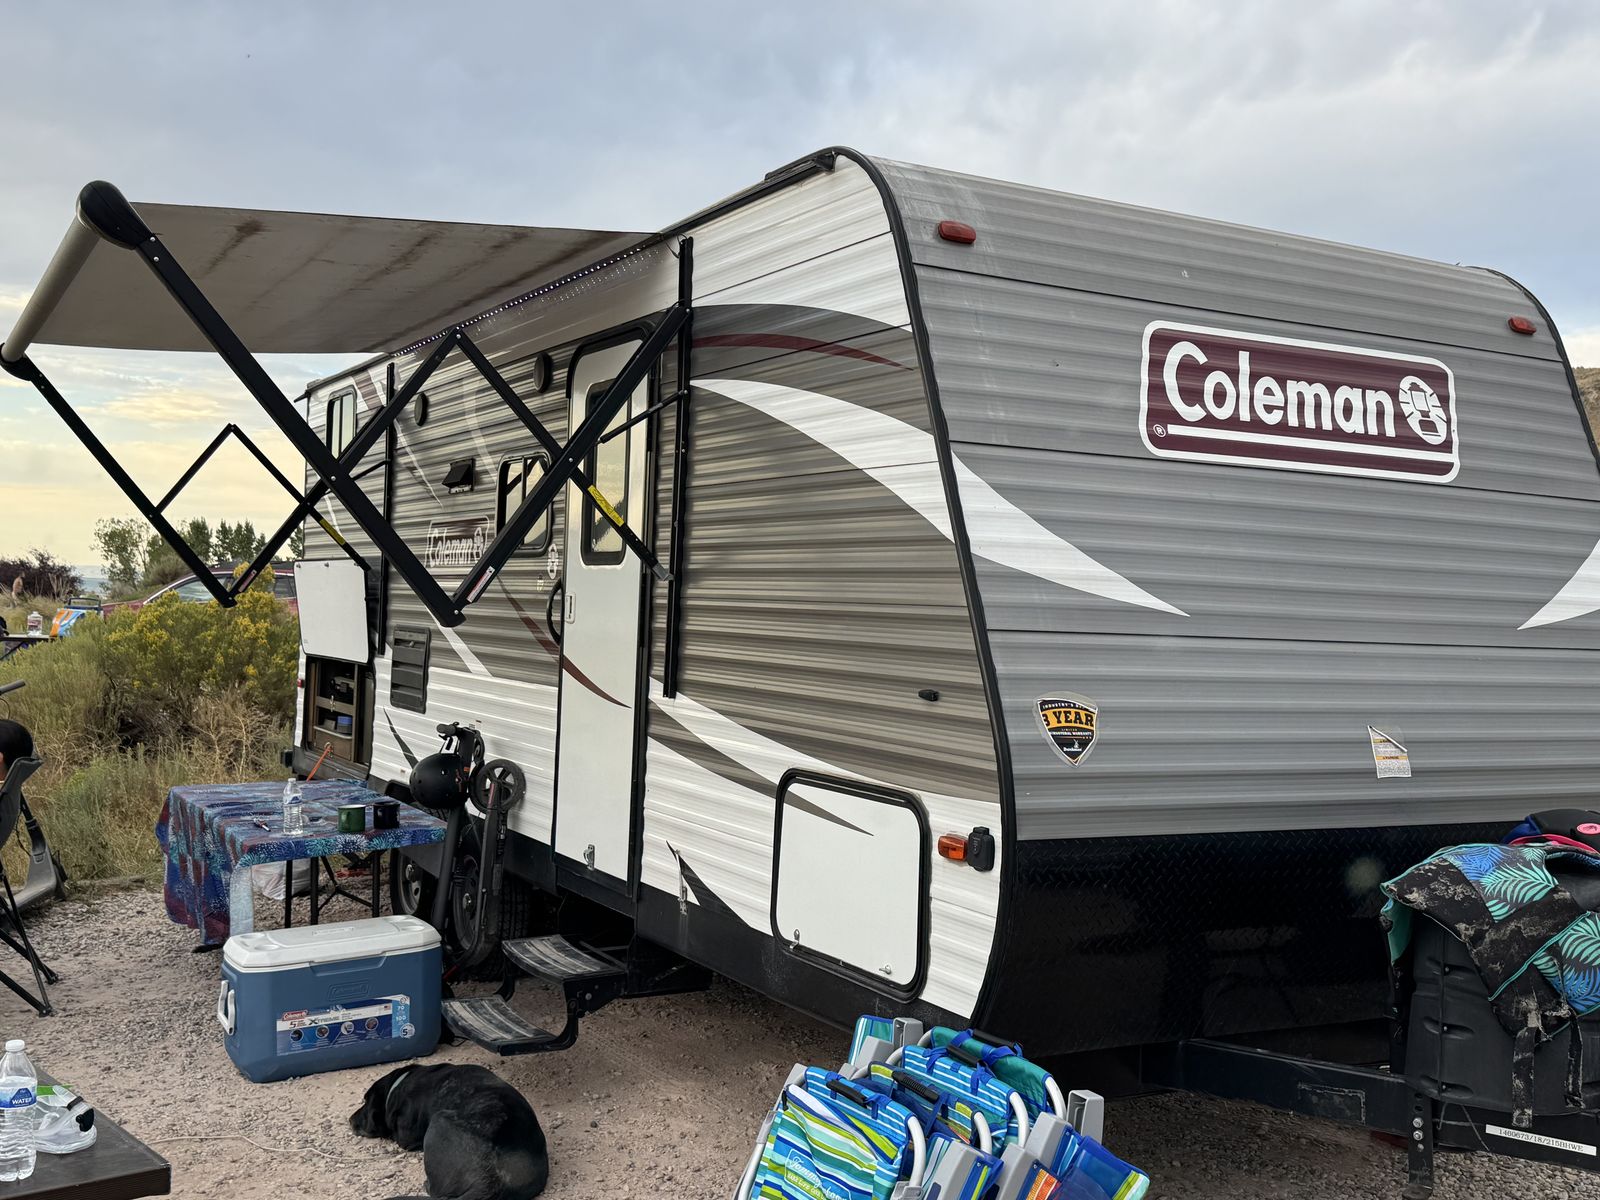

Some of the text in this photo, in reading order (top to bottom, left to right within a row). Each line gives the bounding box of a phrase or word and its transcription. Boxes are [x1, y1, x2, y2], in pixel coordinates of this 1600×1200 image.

[1163, 340, 1396, 438] Coleman
[429, 528, 473, 567] Coleman
[1042, 711, 1094, 727] 3 YEAR
